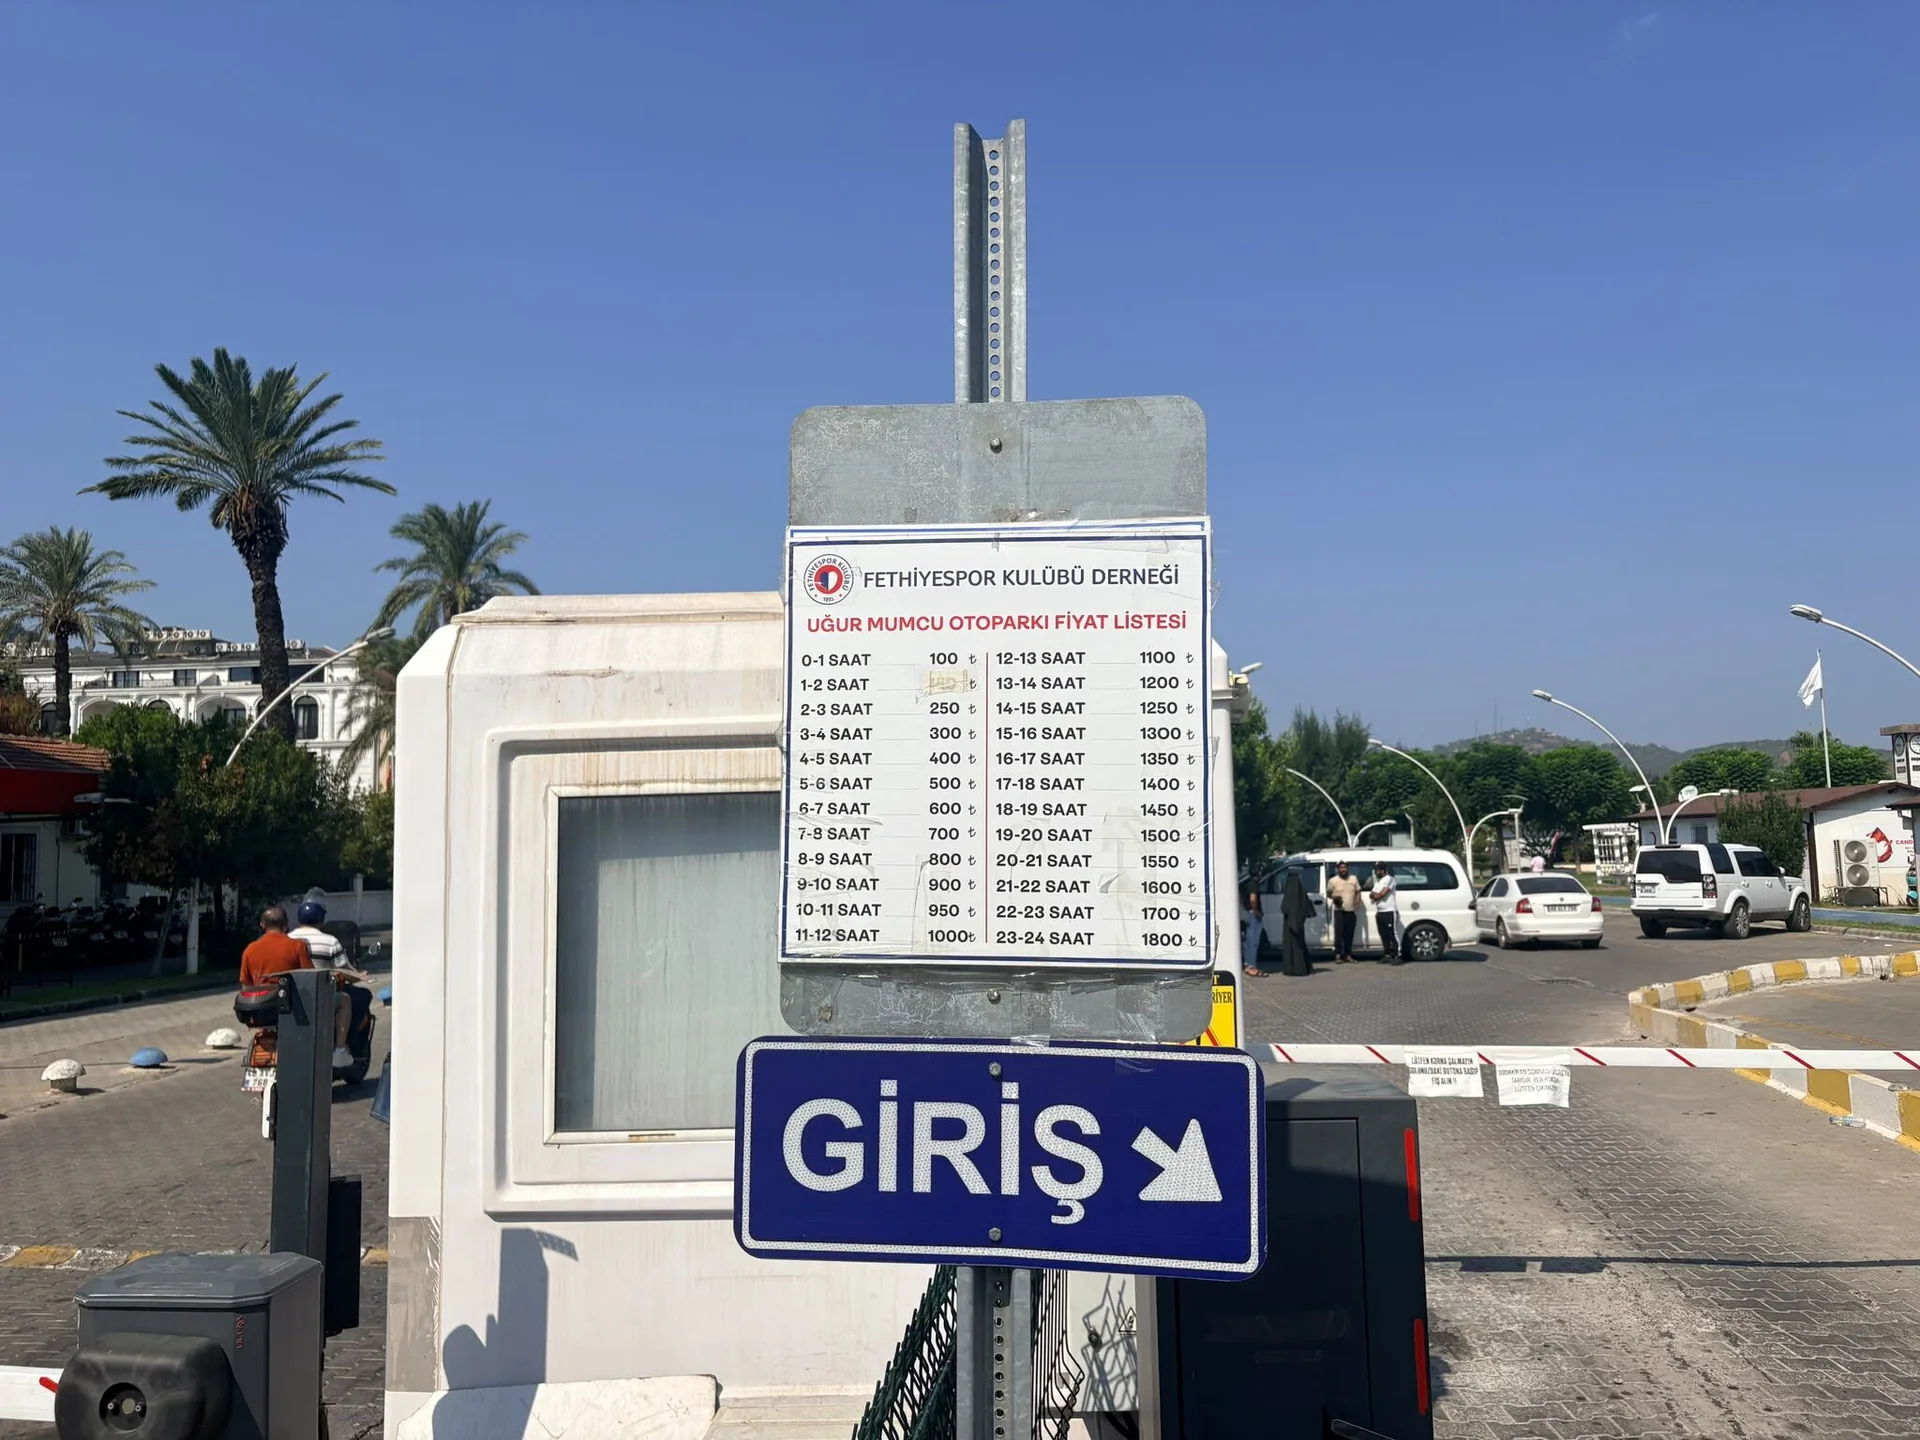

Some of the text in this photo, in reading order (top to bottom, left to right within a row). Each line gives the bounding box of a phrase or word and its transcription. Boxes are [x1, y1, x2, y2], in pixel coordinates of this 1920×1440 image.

[864, 563, 1180, 588] FETHİYESPOR KULÜBÜ DERNEĞİ
[807, 610, 1188, 633] UĞUR MUMCU OTOPARKI FİYAT LİSTESİ
[801, 654, 824, 667] 0-1
[828, 653, 871, 667] SAAT
[929, 652, 958, 665] 100
[996, 652, 1037, 665] 12-13
[1041, 651, 1086, 665] SAAT
[1139, 651, 1176, 664] 1100
[800, 678, 823, 691] 1-2
[827, 678, 870, 691] SAAT
[996, 677, 1037, 690] 13-14
[1041, 676, 1086, 690] SAAT
[1139, 676, 1180, 689] 1200
[800, 703, 826, 716] 2-3
[830, 703, 874, 716] SAAT
[929, 701, 960, 715] 250
[996, 702, 1037, 715] 14-15
[1041, 701, 1086, 715] SAAT
[1139, 701, 1178, 715] 1250
[800, 727, 826, 741] 3-4
[830, 727, 873, 741] SAAT
[929, 726, 962, 740] 300
[995, 727, 1037, 740] 15-16
[1041, 727, 1087, 740] SAAT
[1139, 726, 1182, 740] 1300
[799, 752, 825, 765] 4-5
[829, 752, 873, 765] SAAT
[929, 751, 961, 765] 400
[995, 752, 1036, 765] 16-17
[1040, 752, 1085, 765] SAAT
[1140, 752, 1179, 766] 1350
[799, 777, 826, 790] 5-6
[829, 777, 873, 790] SAAT
[929, 776, 961, 790] 500
[995, 777, 1036, 791] 17-18
[1040, 777, 1085, 791] SAAT
[1140, 777, 1180, 791] 1400
[799, 802, 824, 815] 6-7
[827, 802, 871, 815] SAAT
[929, 802, 962, 815] 600
[995, 802, 1038, 816] 18-19
[1042, 803, 1087, 816] SAAT
[1140, 803, 1179, 817] 1450
[798, 827, 823, 840] 7-8
[827, 827, 871, 841] SAAT
[928, 827, 960, 841] 700
[995, 828, 1043, 842] 19-20
[1047, 828, 1093, 842] SAAT
[1140, 829, 1181, 843] 1500
[798, 852, 825, 866] 8-9
[829, 852, 873, 866] SAAT
[928, 852, 962, 866] 800
[996, 853, 1042, 867] 20-21
[1047, 854, 1092, 868] SAAT
[1140, 855, 1179, 869] 1550
[797, 877, 832, 891] 9-10
[835, 878, 880, 891] SAAT
[928, 878, 962, 892] 900
[996, 879, 1041, 893] 21-22
[1045, 880, 1091, 894] SAAT
[1141, 880, 1182, 895] 1600
[796, 903, 833, 916] 10-11
[837, 903, 882, 917] SAAT
[928, 903, 960, 917] 950
[996, 905, 1045, 919] 22-23
[1049, 905, 1095, 920] SAAT
[1141, 907, 1181, 921] 1700
[795, 928, 832, 942] 11-12
[835, 928, 880, 942] SAAT
[996, 930, 1045, 945] 23-24
[1049, 931, 1095, 946] SAAT
[1141, 932, 1183, 947] 1800
[1212, 989, 1233, 1004] RİYER
[782, 1079, 1104, 1226] GİRİŞ
